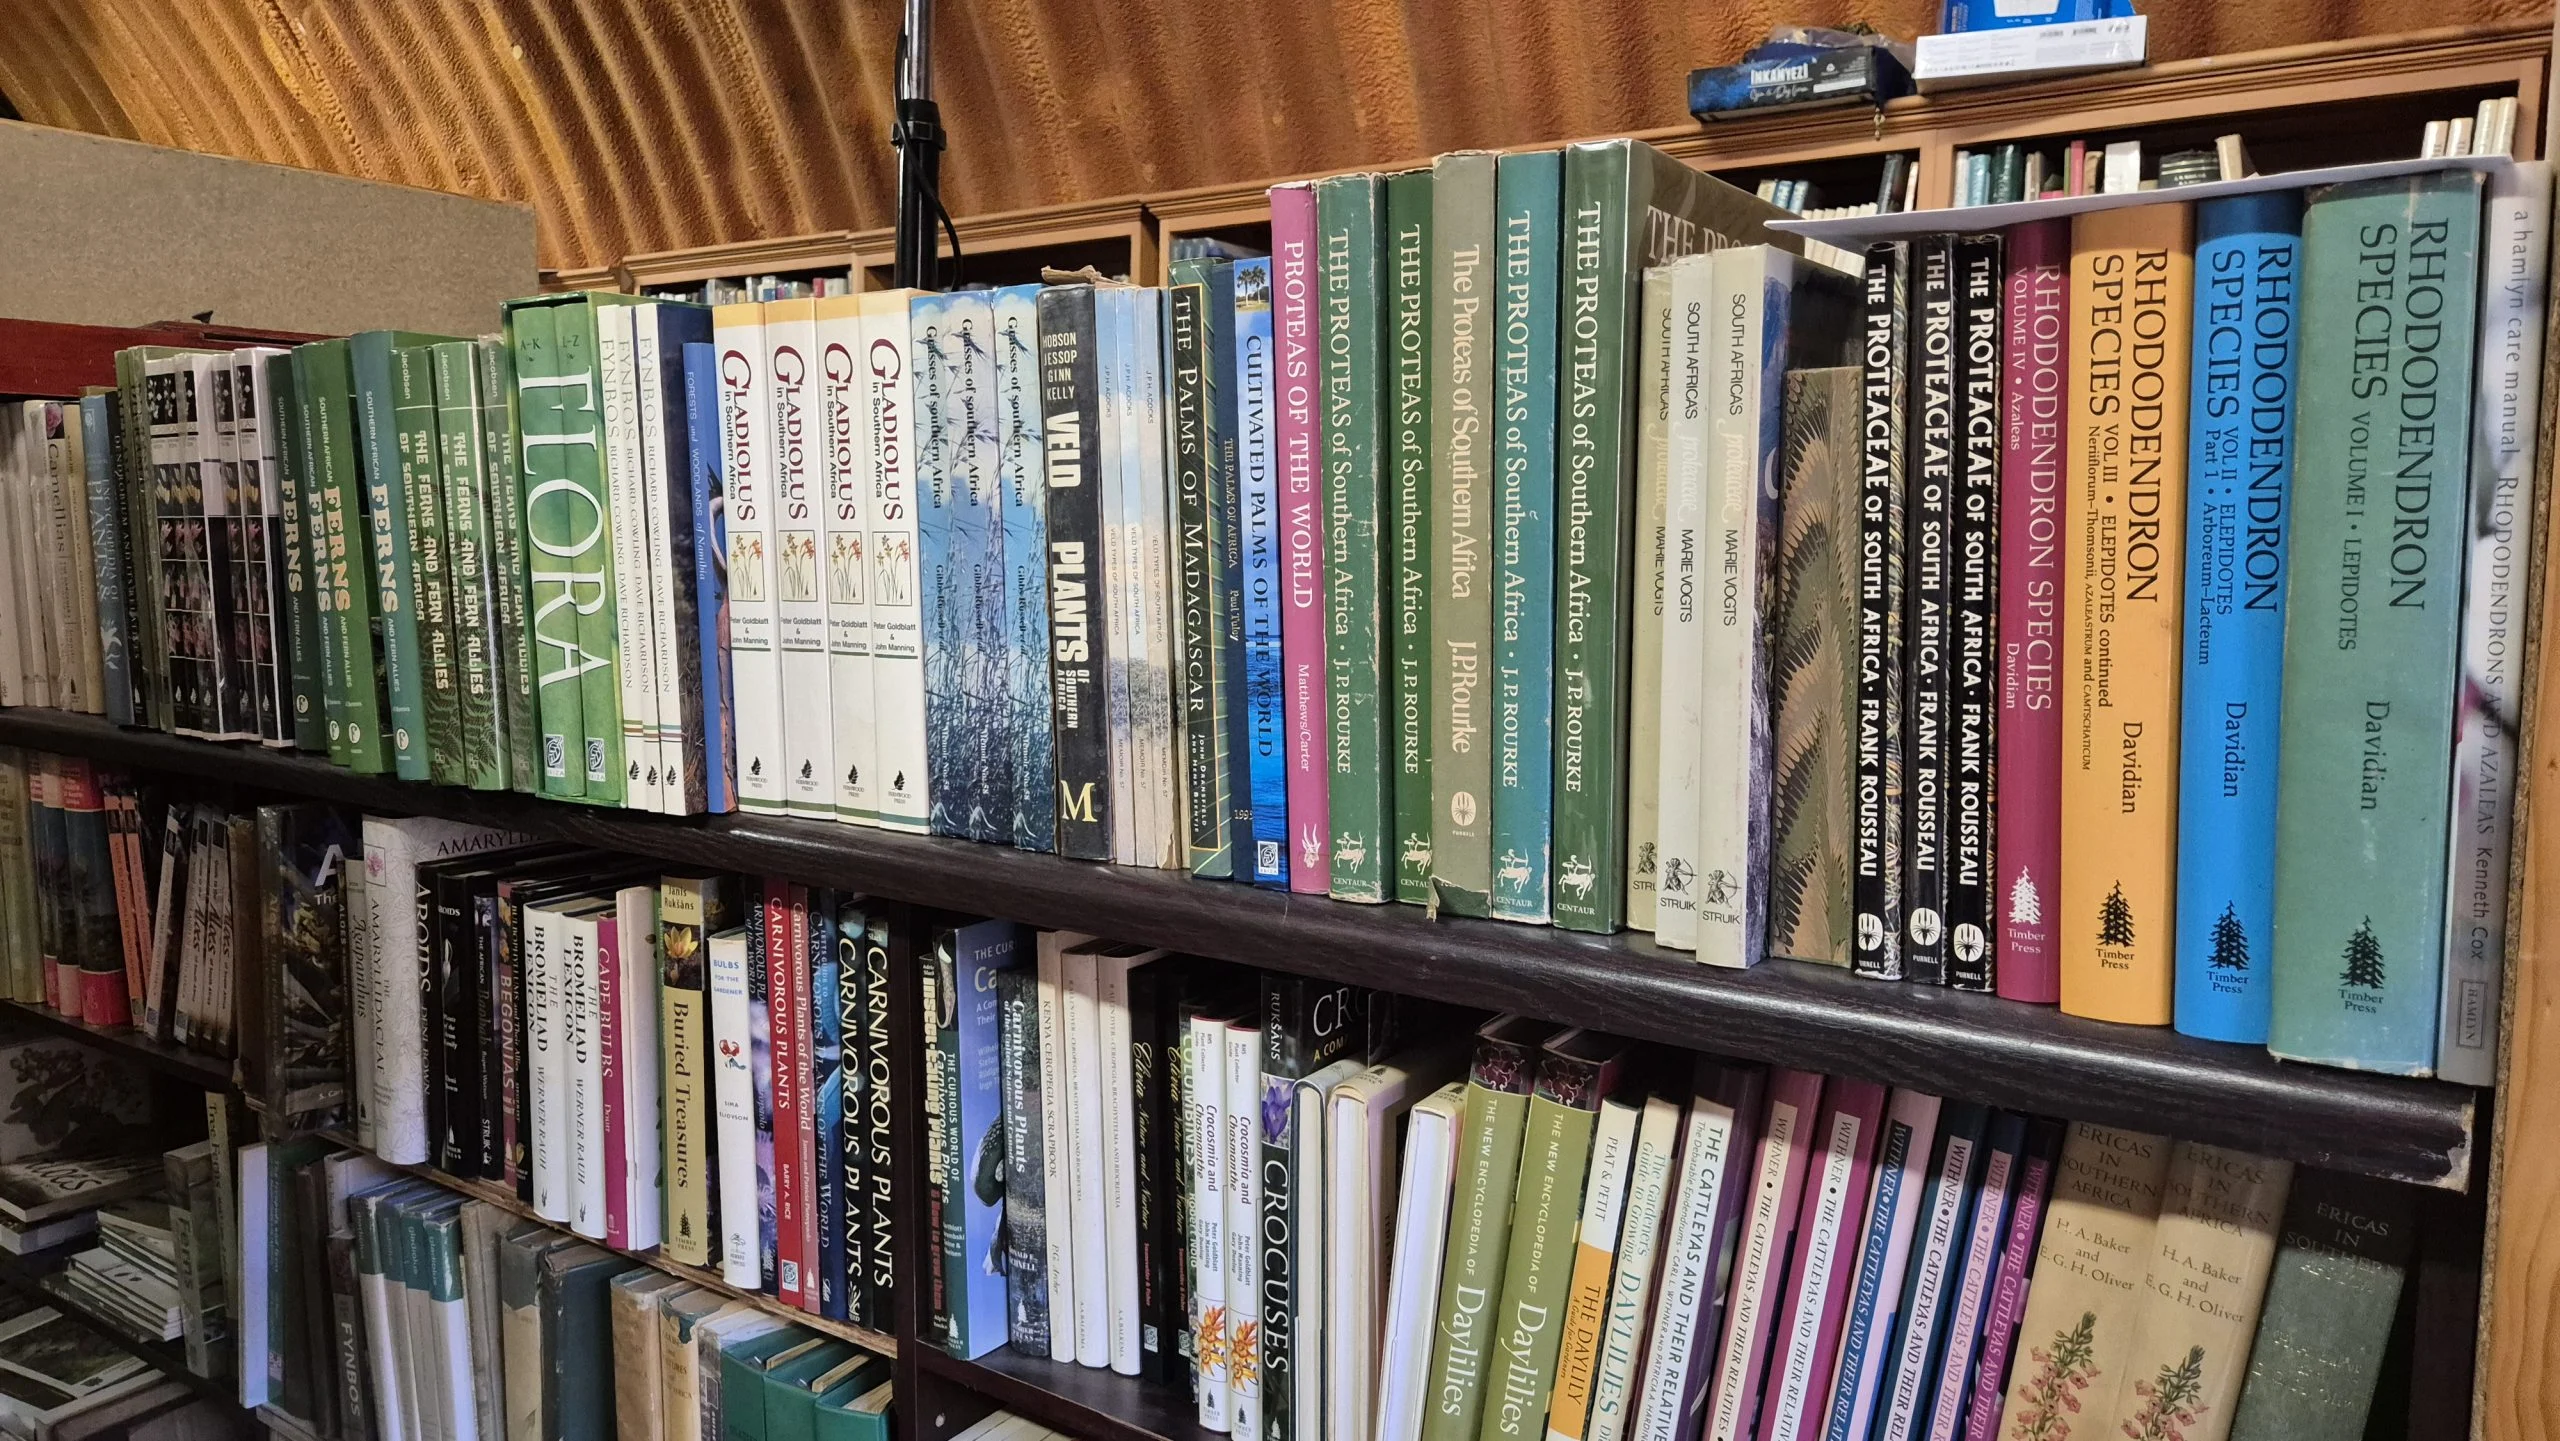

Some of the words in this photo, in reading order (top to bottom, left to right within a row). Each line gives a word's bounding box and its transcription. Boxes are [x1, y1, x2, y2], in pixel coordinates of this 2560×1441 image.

[1576, 201, 1601, 270] THE
[2514, 210, 2528, 222] a
[1454, 244, 1479, 293] The
[1969, 257, 1990, 298] THE
[2504, 229, 2528, 315] hamlyn
[1176, 296, 1192, 352] THE
[1284, 239, 1307, 379] PROTEAS
[1732, 293, 1745, 347] SOUTH
[2014, 267, 2028, 344] VOLUME
[2089, 254, 2124, 418] SPECIES
[2206, 249, 2245, 418] SPECIES
[2351, 223, 2398, 400] SPECIES
[1043, 332, 1076, 347] HOBSON
[1044, 350, 1077, 366] JESSOP
[1453, 299, 1479, 385] Proteas
[1573, 275, 1599, 418] PROTEAS
[2012, 352, 2025, 370] IV
[2506, 318, 2521, 363] care
[640, 338, 656, 438] FYNBOS
[872, 382, 880, 392] in
[1047, 369, 1071, 383] GINN
[1047, 385, 1074, 401] KELLY
[1454, 388, 1476, 413] of
[1729, 350, 1744, 416] AFRICA'S
[1966, 308, 1994, 489] PROTEACEAE
[870, 338, 903, 520] GLADIOLUS
[872, 395, 881, 456] Southern
[1179, 366, 1198, 455] PALMS
[1246, 335, 1265, 483] CULTIVATED
[1288, 385, 1309, 432] OF
[1572, 423, 1595, 448] of
[2010, 392, 2025, 451] Azaleas
[2029, 264, 2059, 568] RHODODENDRON
[2126, 247, 2168, 602] RHODODENDRON
[2244, 244, 2293, 613] RHODODENDRON
[2389, 218, 2449, 611] RHODODENDRON
[2499, 370, 2521, 455] manual
[414, 431, 428, 464] THE
[1046, 411, 1081, 488] VELD
[1289, 436, 1312, 494] THE
[1452, 412, 1478, 528] Southern
[2102, 423, 2119, 463] VOL
[2102, 465, 2118, 485] III
[2204, 430, 2220, 466] Part
[2204, 469, 2219, 480] 1
[2221, 466, 2238, 481] II
[2222, 424, 2239, 463] VOL
[2348, 411, 2371, 505] VOLUME
[418, 474, 434, 527] FERNS
[875, 460, 883, 498] Africa
[1182, 470, 1198, 507] OF
[1570, 450, 1594, 562] Southern
[1966, 494, 1985, 522] OF
[518, 365, 611, 690] FLORA
[1250, 491, 1268, 569] PALMS
[2345, 511, 2365, 519] I
[371, 484, 398, 612] FERNS
[424, 537, 438, 573] AND
[1290, 502, 1314, 608] WORLD
[1452, 531, 1477, 599] Africa
[1725, 530, 1737, 574] MARIE
[1964, 531, 1984, 602] SOUTH
[2099, 515, 2116, 623] ELEPIDOTES
[2216, 503, 2236, 616] ELEPIDOTES
[428, 580, 443, 622] FERN
[1050, 541, 1089, 662] PLANTS
[1253, 577, 1268, 609] OF
[1568, 570, 1591, 643] Africa
[1723, 576, 1736, 626] VOGTS
[2339, 538, 2363, 651] LEPIDOTES
[2486, 477, 2519, 685] RHODODENDRONS
[887, 622, 916, 631] Goldblatt
[888, 644, 915, 653] Manning
[1185, 522, 1204, 711] MADAGASCAR
[1254, 613, 1270, 664] THE
[1962, 610, 1983, 687] AFRICA
[2025, 580, 2054, 711] SPECIES
[2083, 583, 2094, 655] AZALEASTRUM
[433, 631, 448, 689] ALLIES
[1056, 669, 1065, 711] AFRICA
[1077, 669, 1089, 684] OF
[2006, 643, 2020, 709] Davidian
[2084, 659, 2095, 681] and
[2098, 627, 2114, 707] continued
[1067, 670, 1078, 729] SOUTHERN
[1255, 667, 1273, 757] WORLD
[1297, 663, 1312, 772] Matthews/Carter
[2081, 683, 2092, 770] CAMTSCHATICUM
[1198, 734, 1206, 760] JOHN
[1961, 703, 1981, 774] FRANK
[2122, 721, 2143, 814] Davidian
[2223, 701, 2247, 798] Davidian
[2360, 700, 2391, 811] Davidian
[1061, 780, 1097, 822] M
[2478, 743, 2500, 835] AZALEAS
[1959, 781, 1980, 886] ROUSSEAU
[1556, 901, 1595, 916] CENTAUR
[2474, 846, 2494, 920] Kenneth
[415, 881, 431, 994] AROIDS
[1702, 910, 1741, 924] STRUIK
[2470, 926, 2489, 960] Cox
[563, 949, 574, 1044] LEXICON
[598, 947, 611, 1005] CAPE
[770, 897, 788, 1035] CARNIVOROUS
[1956, 969, 1981, 980] PURNELL
[2206, 971, 2249, 985] Timber
[2212, 981, 2243, 994] Press
[2337, 988, 2385, 1004] Timber
[574, 935, 587, 1064] BROMELIAD
[2344, 1000, 2377, 1015] Press
[2463, 988, 2479, 1041] HAMLYN
[499, 975, 514, 1095] BEGONIAS
[600, 1009, 613, 1077] BULBS
[673, 1001, 691, 1081] Buried
[867, 946, 891, 1166] CARNIVOROUS
[776, 1039, 790, 1110] PLANTS
[674, 1082, 691, 1189] Treasures
[1482, 1127, 1493, 1157] NEW
[1487, 1099, 1497, 1124] THE
[2078, 1122, 2154, 1159] ERICAS
[1228, 1114, 1238, 1191] Chasmanthe
[1240, 1116, 1251, 1180] Crocosmia
[1601, 1171, 1613, 1181] &
[1605, 1136, 1618, 1169] PEAT
[1767, 1117, 1788, 1178] WITHNER
[1241, 1182, 1251, 1204] and
[1469, 1161, 1489, 1255] ENCYCLOPEDIA
[1595, 1185, 1610, 1222] PETIT
[1758, 1193, 1773, 1222] THE
[872, 1175, 894, 1288] PLANTS
[1744, 1223, 1768, 1292] CATTLEYAS
[2075, 1246, 2100, 1263] and
[2094, 1232, 2131, 1256] Baker
[1263, 1159, 1289, 1373] CROCUSES
[1467, 1258, 1477, 1277] OF
[2092, 1267, 2136, 1292] Oliver
[1586, 1284, 1602, 1323] THE
[1740, 1294, 1754, 1323] AND
[1441, 1283, 1486, 1418] Daylilies
[1568, 1325, 1594, 1407] DAYLILY
[1599, 1270, 1641, 1417] DAYLILIES
[1732, 1325, 1748, 1364] THEIR
[1717, 1366, 1739, 1432] RELATIVES
